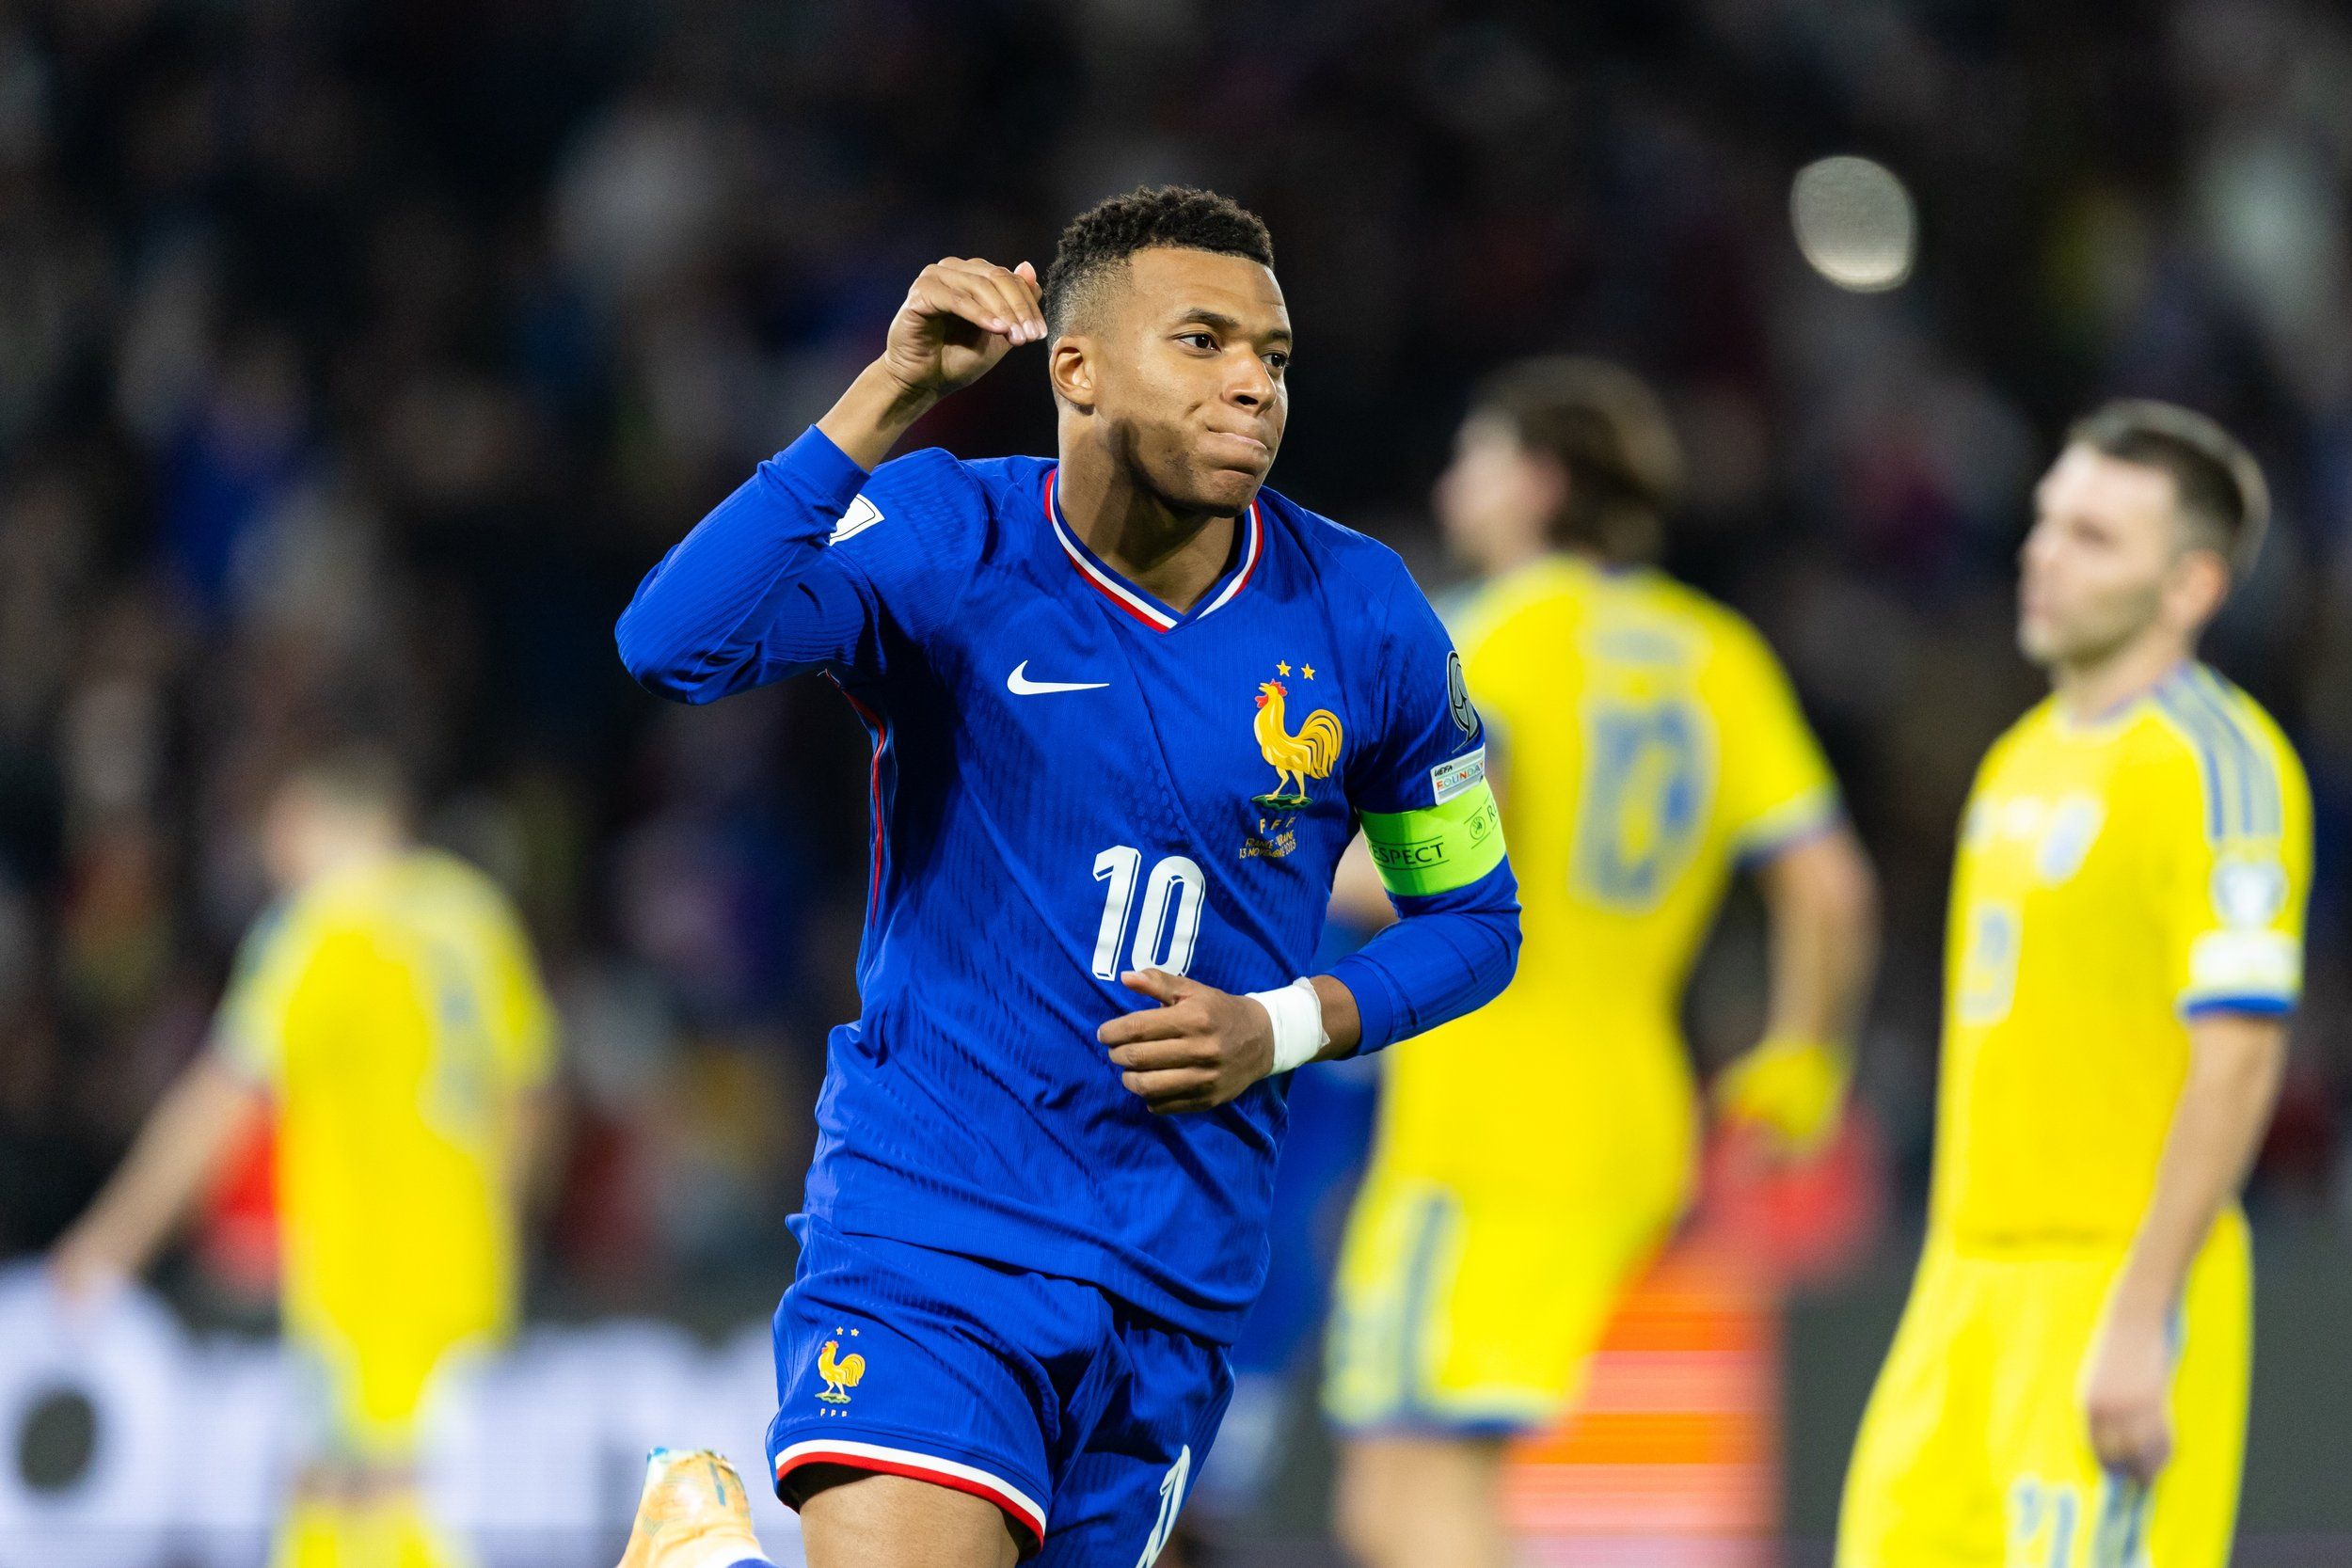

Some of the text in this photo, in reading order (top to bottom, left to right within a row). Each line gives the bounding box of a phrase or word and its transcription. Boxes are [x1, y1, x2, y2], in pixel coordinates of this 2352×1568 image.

[1434, 765, 1453, 777] UEFA
[1239, 848, 1247, 859] 13
[1091, 845, 1206, 982] 10
